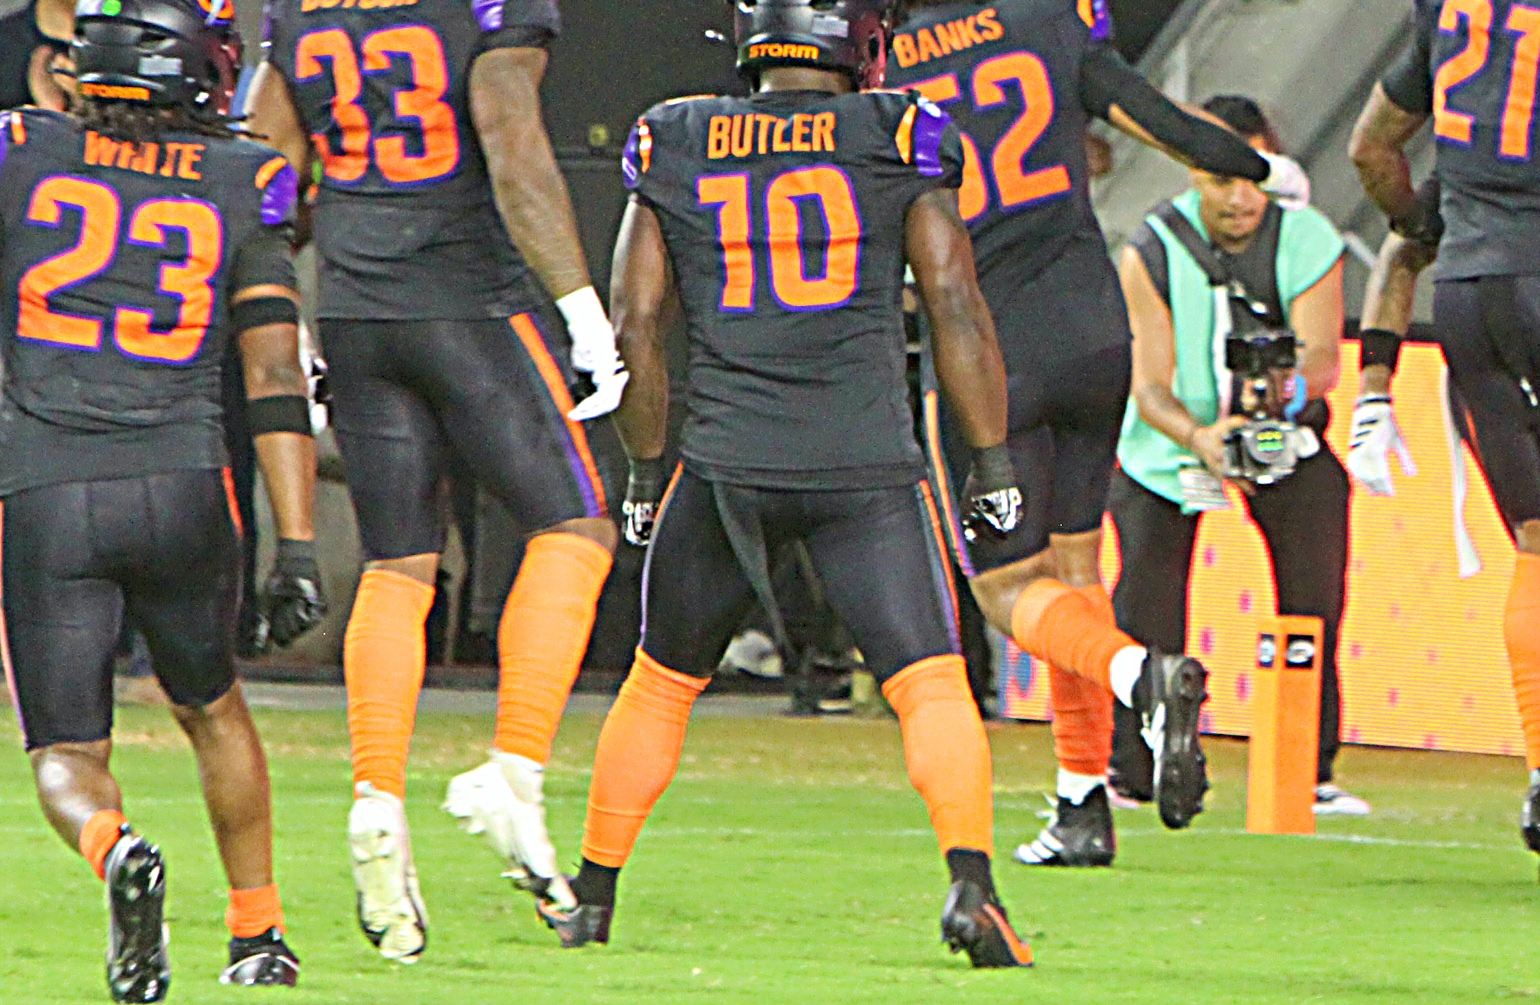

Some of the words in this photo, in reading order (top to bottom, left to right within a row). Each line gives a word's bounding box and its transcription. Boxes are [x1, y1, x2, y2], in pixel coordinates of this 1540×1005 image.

[750, 43, 820, 60] STORM
[893, 8, 1004, 68] BANKS
[295, 25, 461, 187] 33
[707, 111, 836, 160] BUTLER
[83, 130, 206, 181] WHITE
[694, 164, 862, 313] 10
[17, 174, 224, 364] 23
